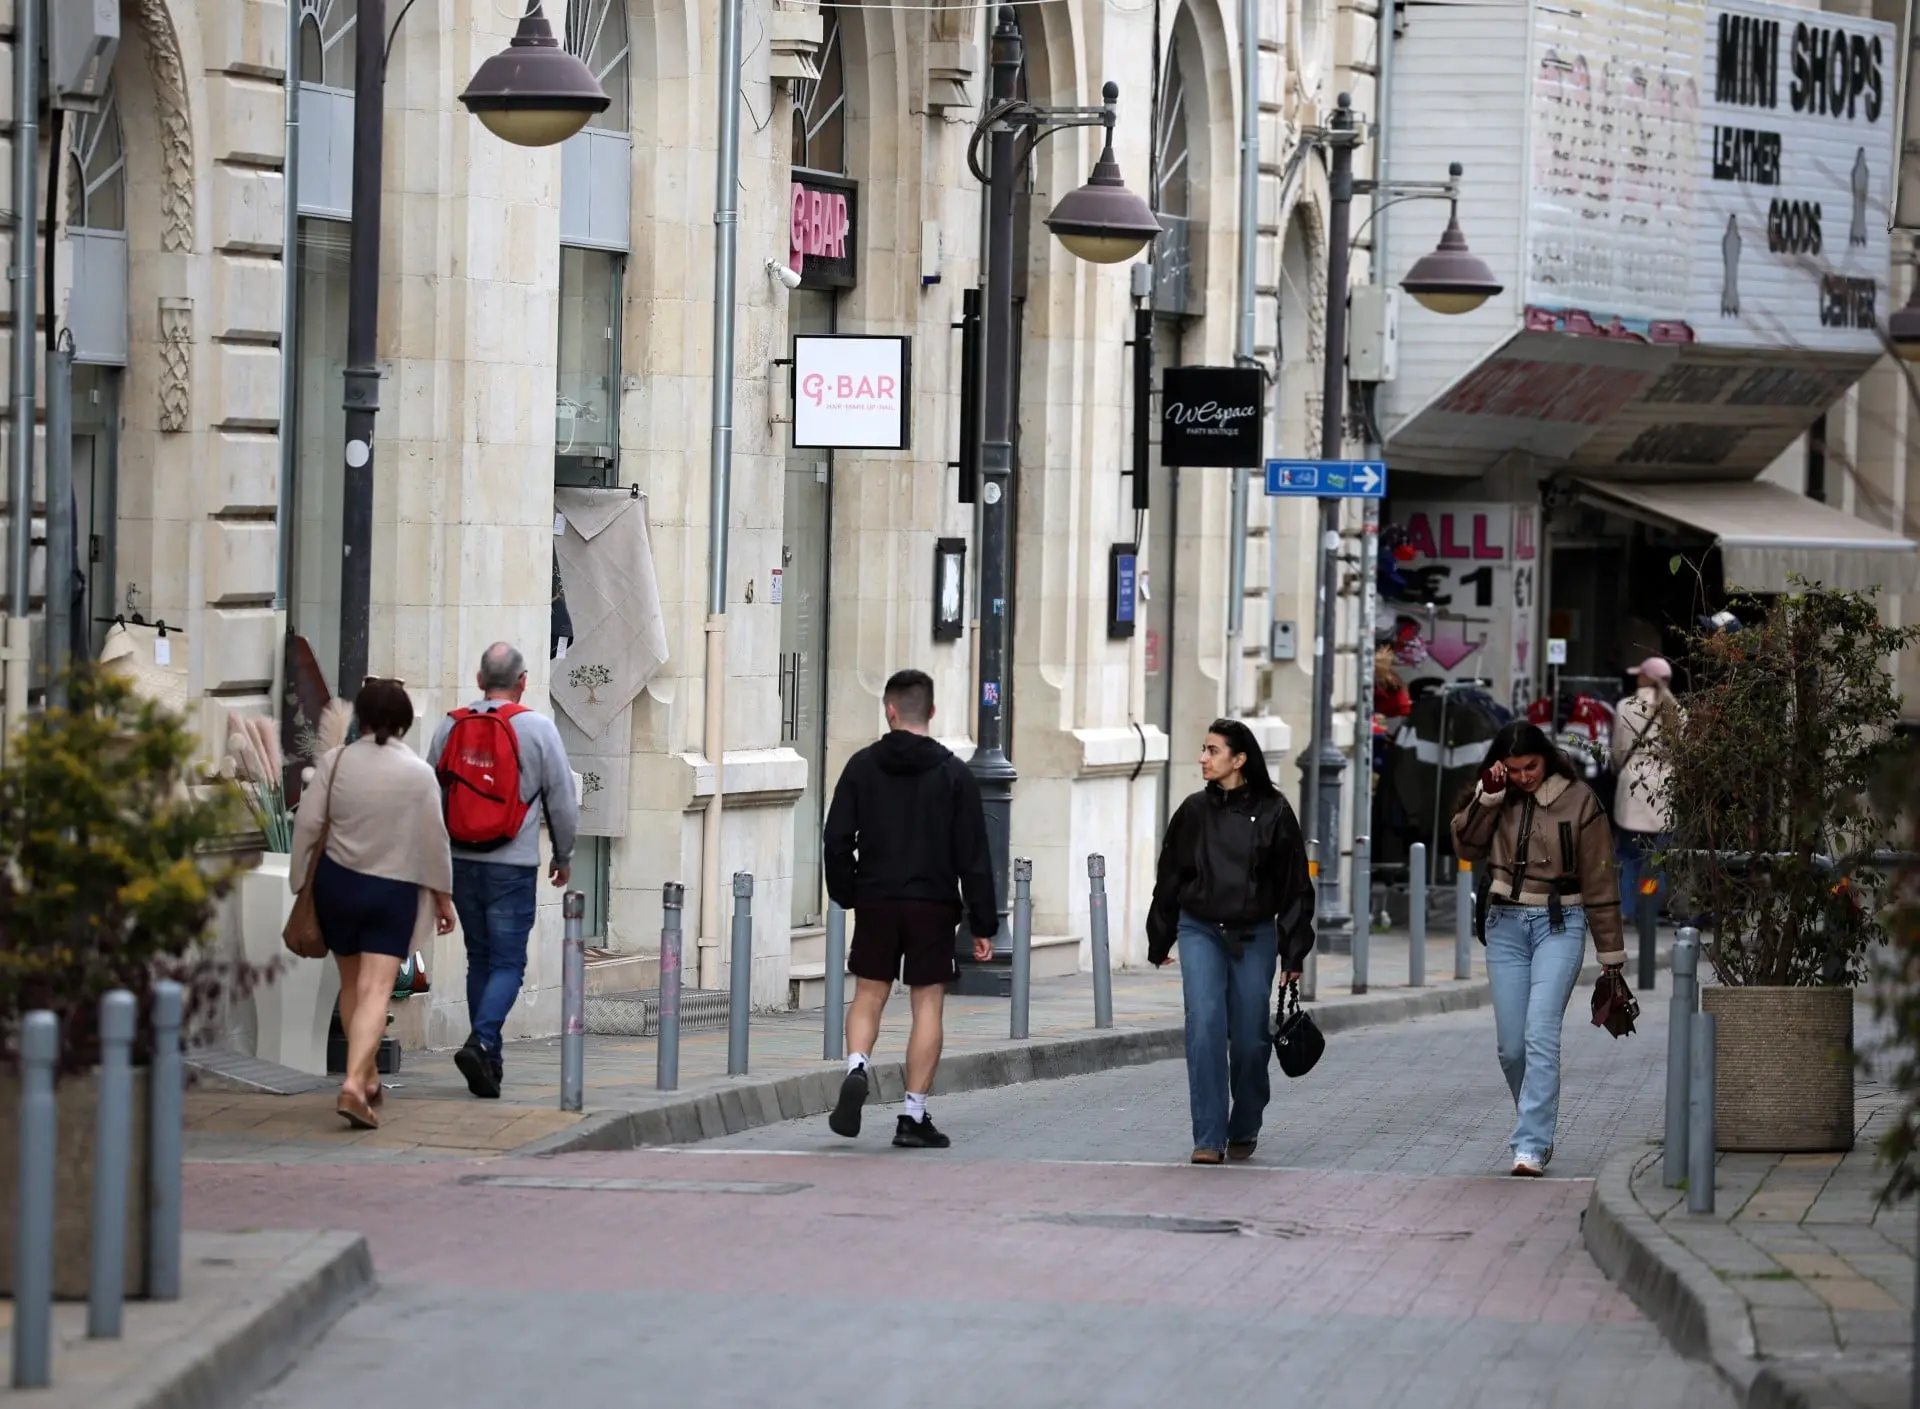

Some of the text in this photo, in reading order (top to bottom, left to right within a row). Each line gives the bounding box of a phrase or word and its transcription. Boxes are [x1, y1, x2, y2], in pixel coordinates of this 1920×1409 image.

[1715, 13, 1884, 123] MINI SHOPS
[1713, 125, 1782, 186] LEATHER
[1768, 197, 1822, 256] GOODS
[1186, 427, 1239, 436] PARTY BOUTIQUE
[1407, 512, 1504, 559] ALL
[1411, 565, 1494, 607] €1
[1513, 566, 1534, 608] €1
